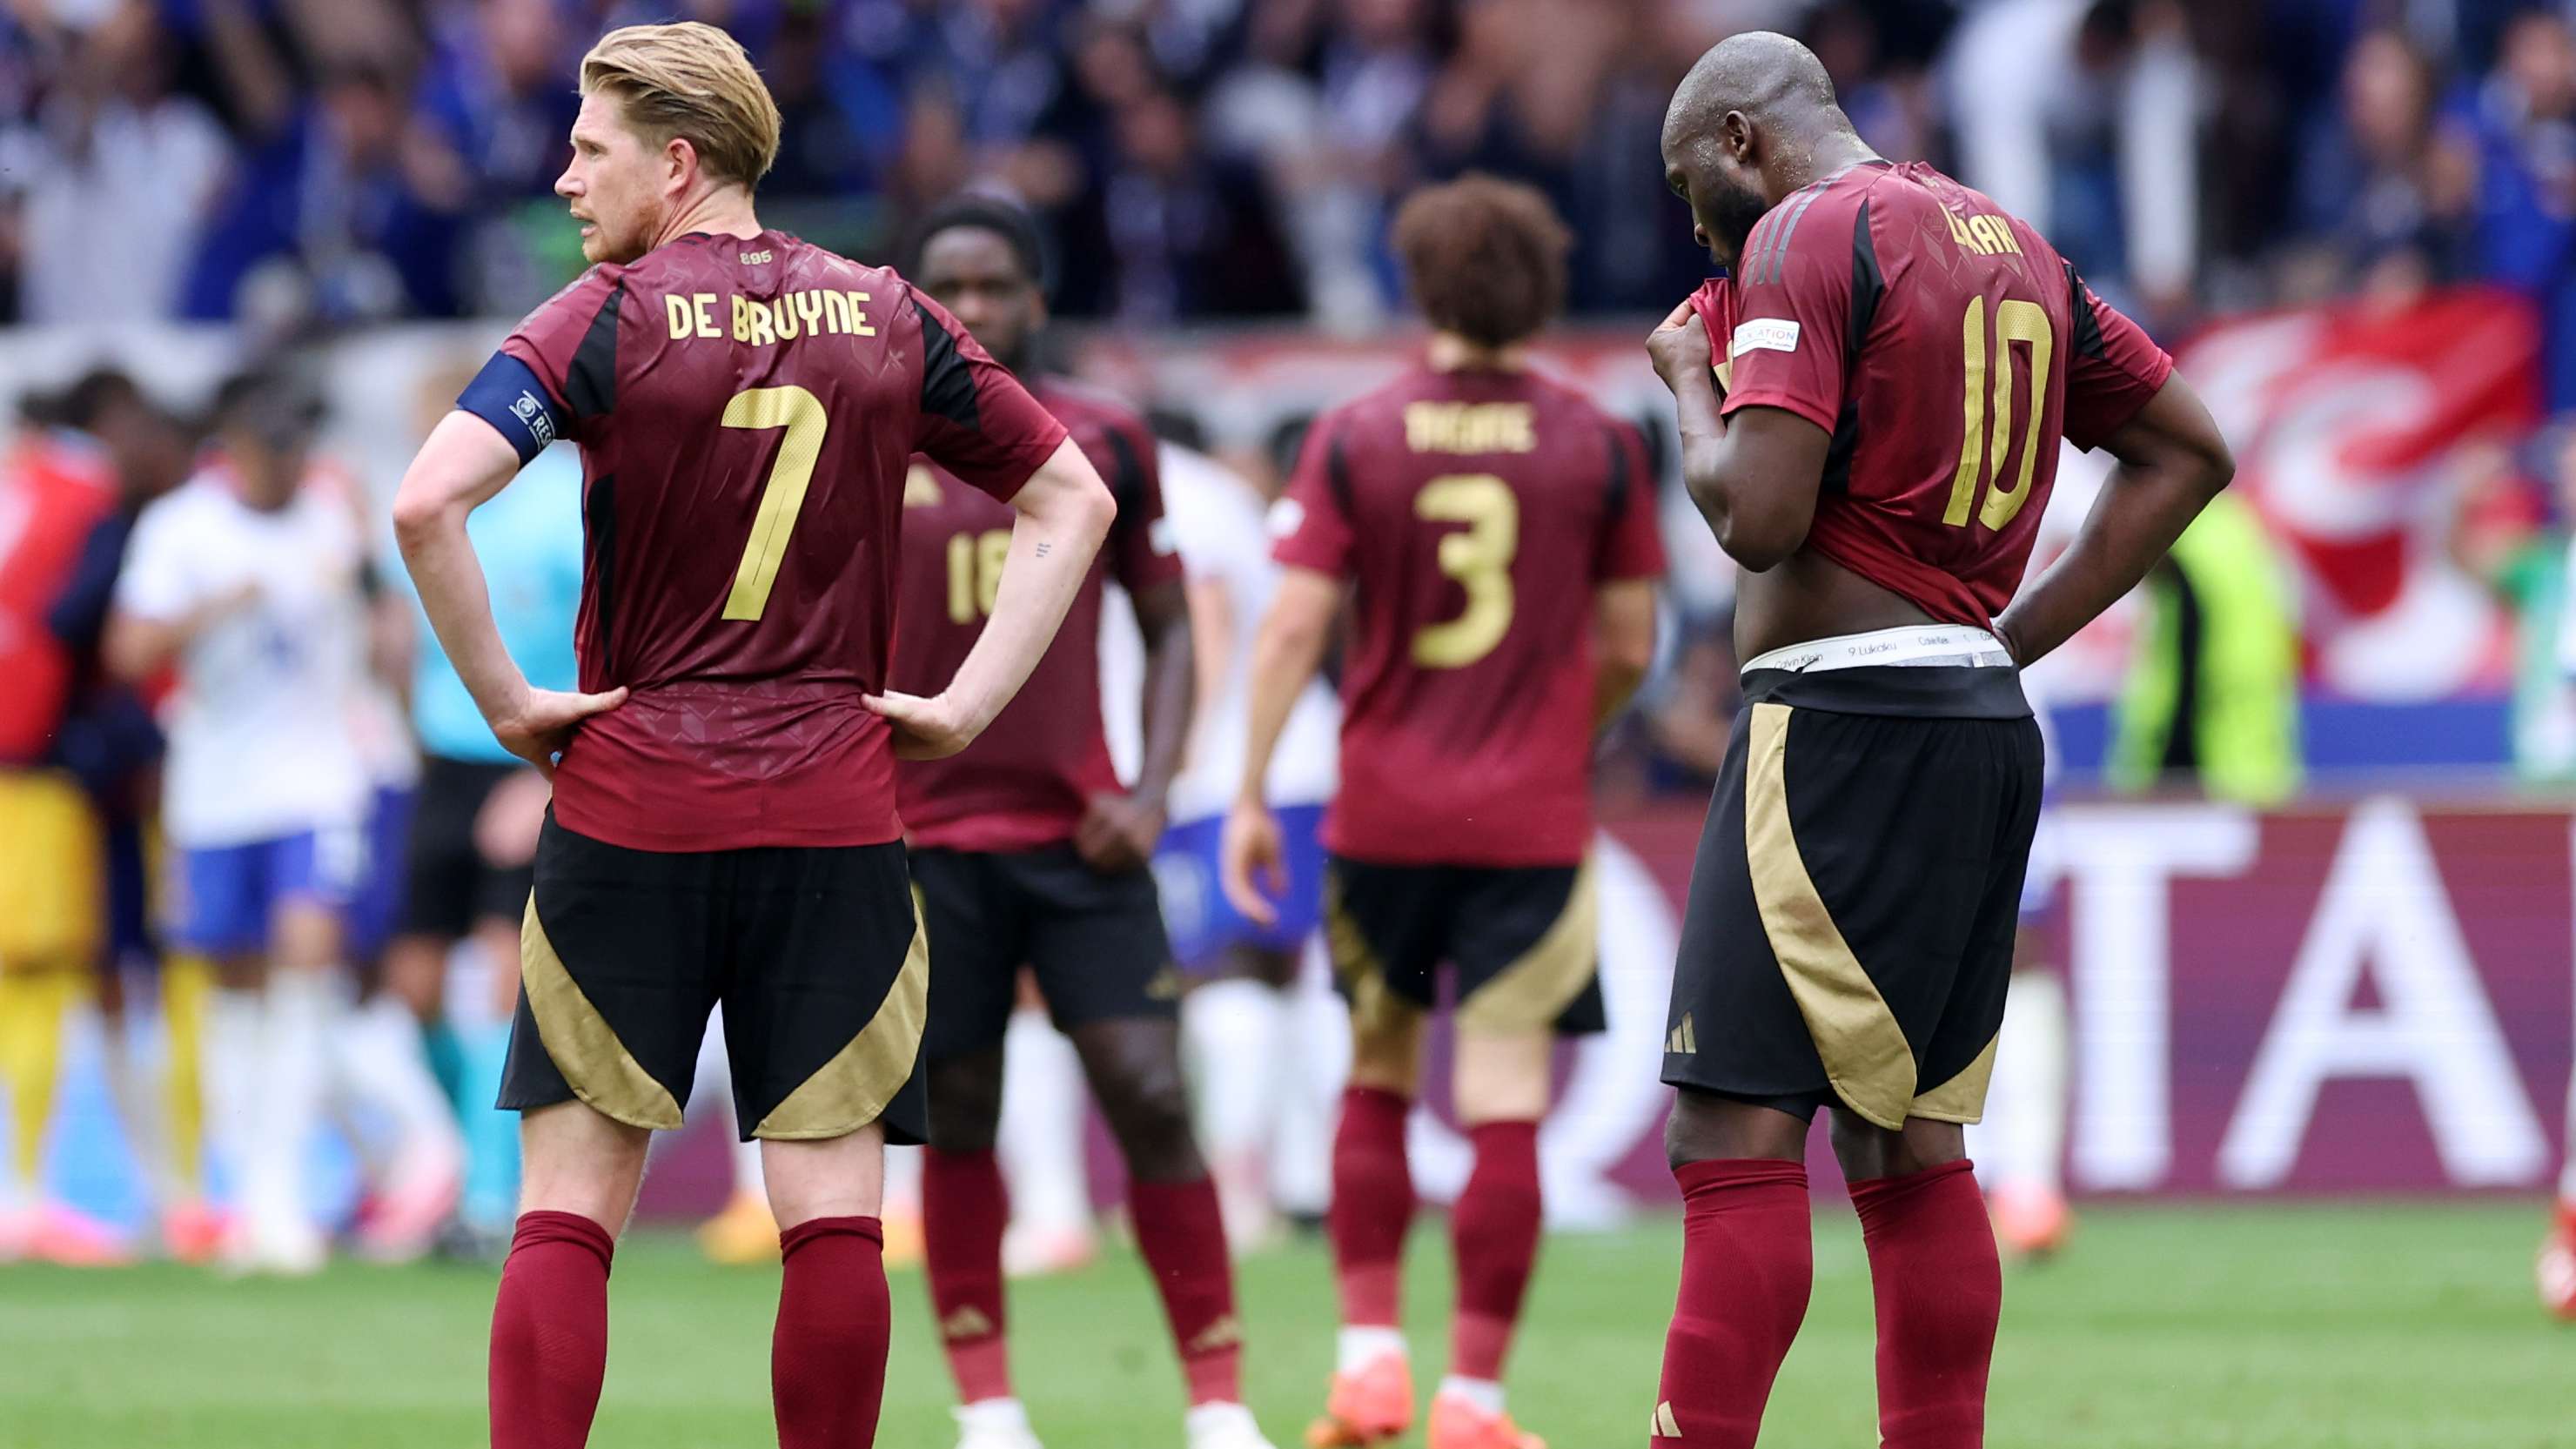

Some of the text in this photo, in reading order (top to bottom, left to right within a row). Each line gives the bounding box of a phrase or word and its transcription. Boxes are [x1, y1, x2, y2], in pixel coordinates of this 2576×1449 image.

[665, 290, 875, 346] DE BRUYNE
[1942, 294, 2052, 531] 10
[721, 385, 828, 621] 7
[1412, 473, 1519, 669] 3
